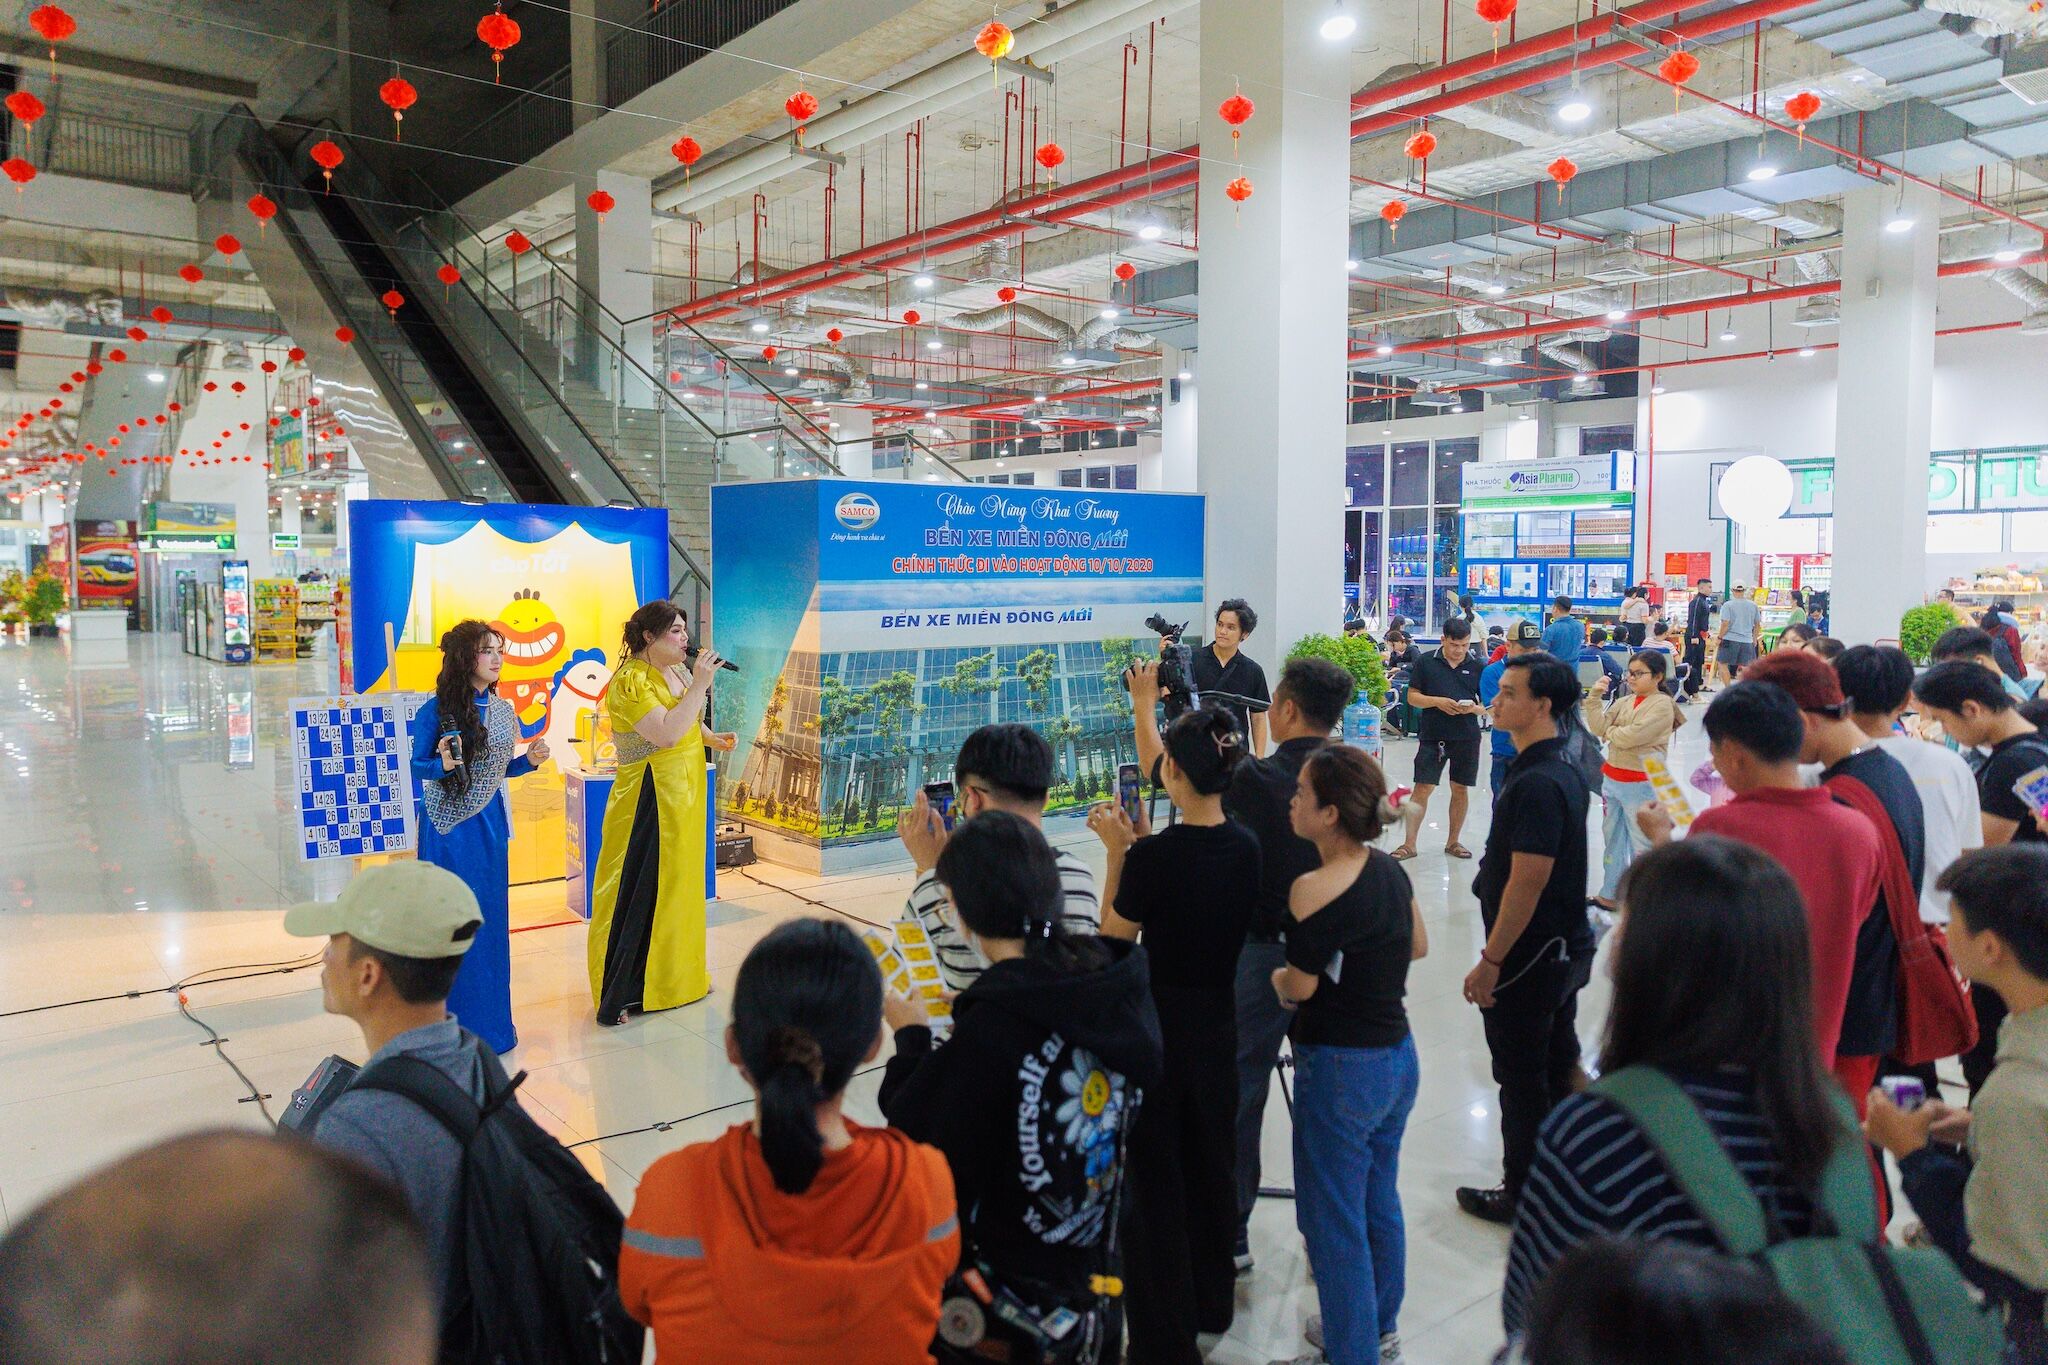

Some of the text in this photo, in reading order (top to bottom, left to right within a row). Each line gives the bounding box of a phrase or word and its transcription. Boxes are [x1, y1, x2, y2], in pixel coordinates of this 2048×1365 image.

[840, 507, 875, 516] SAMCO
[937, 492, 976, 520] Chào
[980, 494, 1027, 523] Mừng
[1031, 496, 1071, 521] Khai
[925, 520, 1129, 550] BẾN XE MIỀN ĐÔNG Mới
[893, 553, 936, 574] CHÍNH
[938, 553, 974, 574] THỨC
[976, 557, 990, 573] ĐI
[991, 553, 1018, 573] VÀO
[1020, 557, 1052, 576] HOẠT
[1053, 554, 1086, 576] ĐỘNG
[881, 607, 1093, 628] BẾN XE MIỀN ĐÔNG Mới
[309, 713, 317, 724] 13
[319, 713, 328, 724] 22
[342, 712, 350, 722] 41
[363, 711, 371, 722] 61
[301, 725, 383, 740] 3 24 34 52 71
[333, 743, 342, 754] 35
[355, 742, 363, 753] 56
[366, 741, 374, 751] 64
[387, 740, 395, 750] 83
[304, 758, 386, 775] 7 23 36 53 75
[305, 780, 309, 791] 5
[357, 776, 366, 786] 59
[380, 774, 388, 785] 72
[390, 773, 398, 784] 84
[316, 794, 324, 804] 14
[348, 792, 357, 803] 42
[369, 791, 378, 800] 60
[327, 805, 401, 821] 26 47 50 79 89
[318, 828, 325, 837] 10
[340, 825, 349, 836] 30
[320, 844, 328, 853] 15
[330, 842, 339, 853] 25
[364, 839, 372, 849] 51
[385, 837, 394, 847] 76
